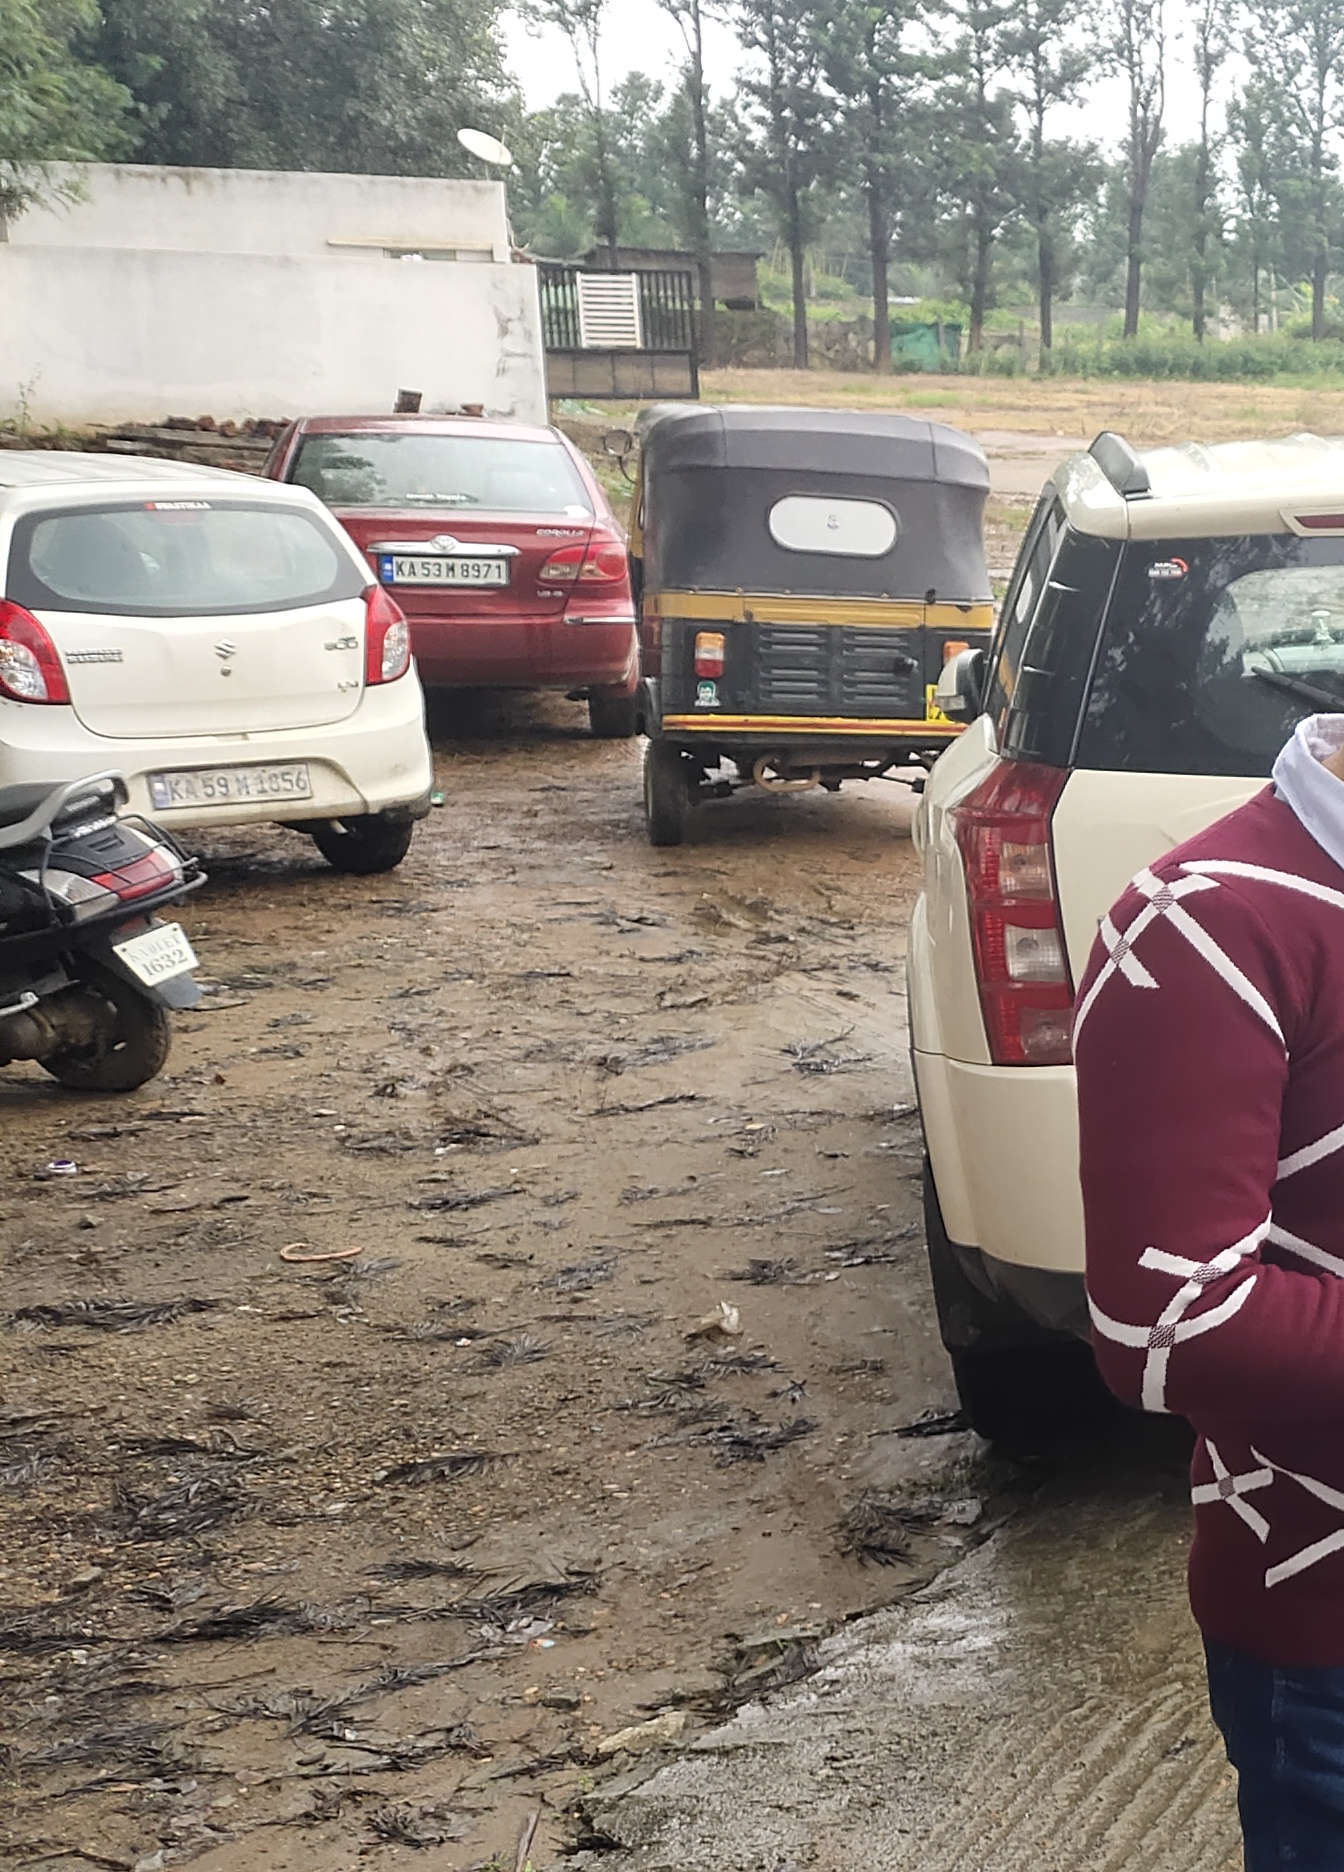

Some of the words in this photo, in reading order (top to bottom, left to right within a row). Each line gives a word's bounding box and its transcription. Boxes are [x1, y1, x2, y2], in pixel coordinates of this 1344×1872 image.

[396, 561, 417, 577] KA
[421, 562, 442, 577] 53
[461, 563, 502, 579] 8971
[168, 778, 198, 801] KA
[202, 777, 229, 798] 59
[255, 771, 307, 794] 1856
[141, 948, 188, 977] 1632
